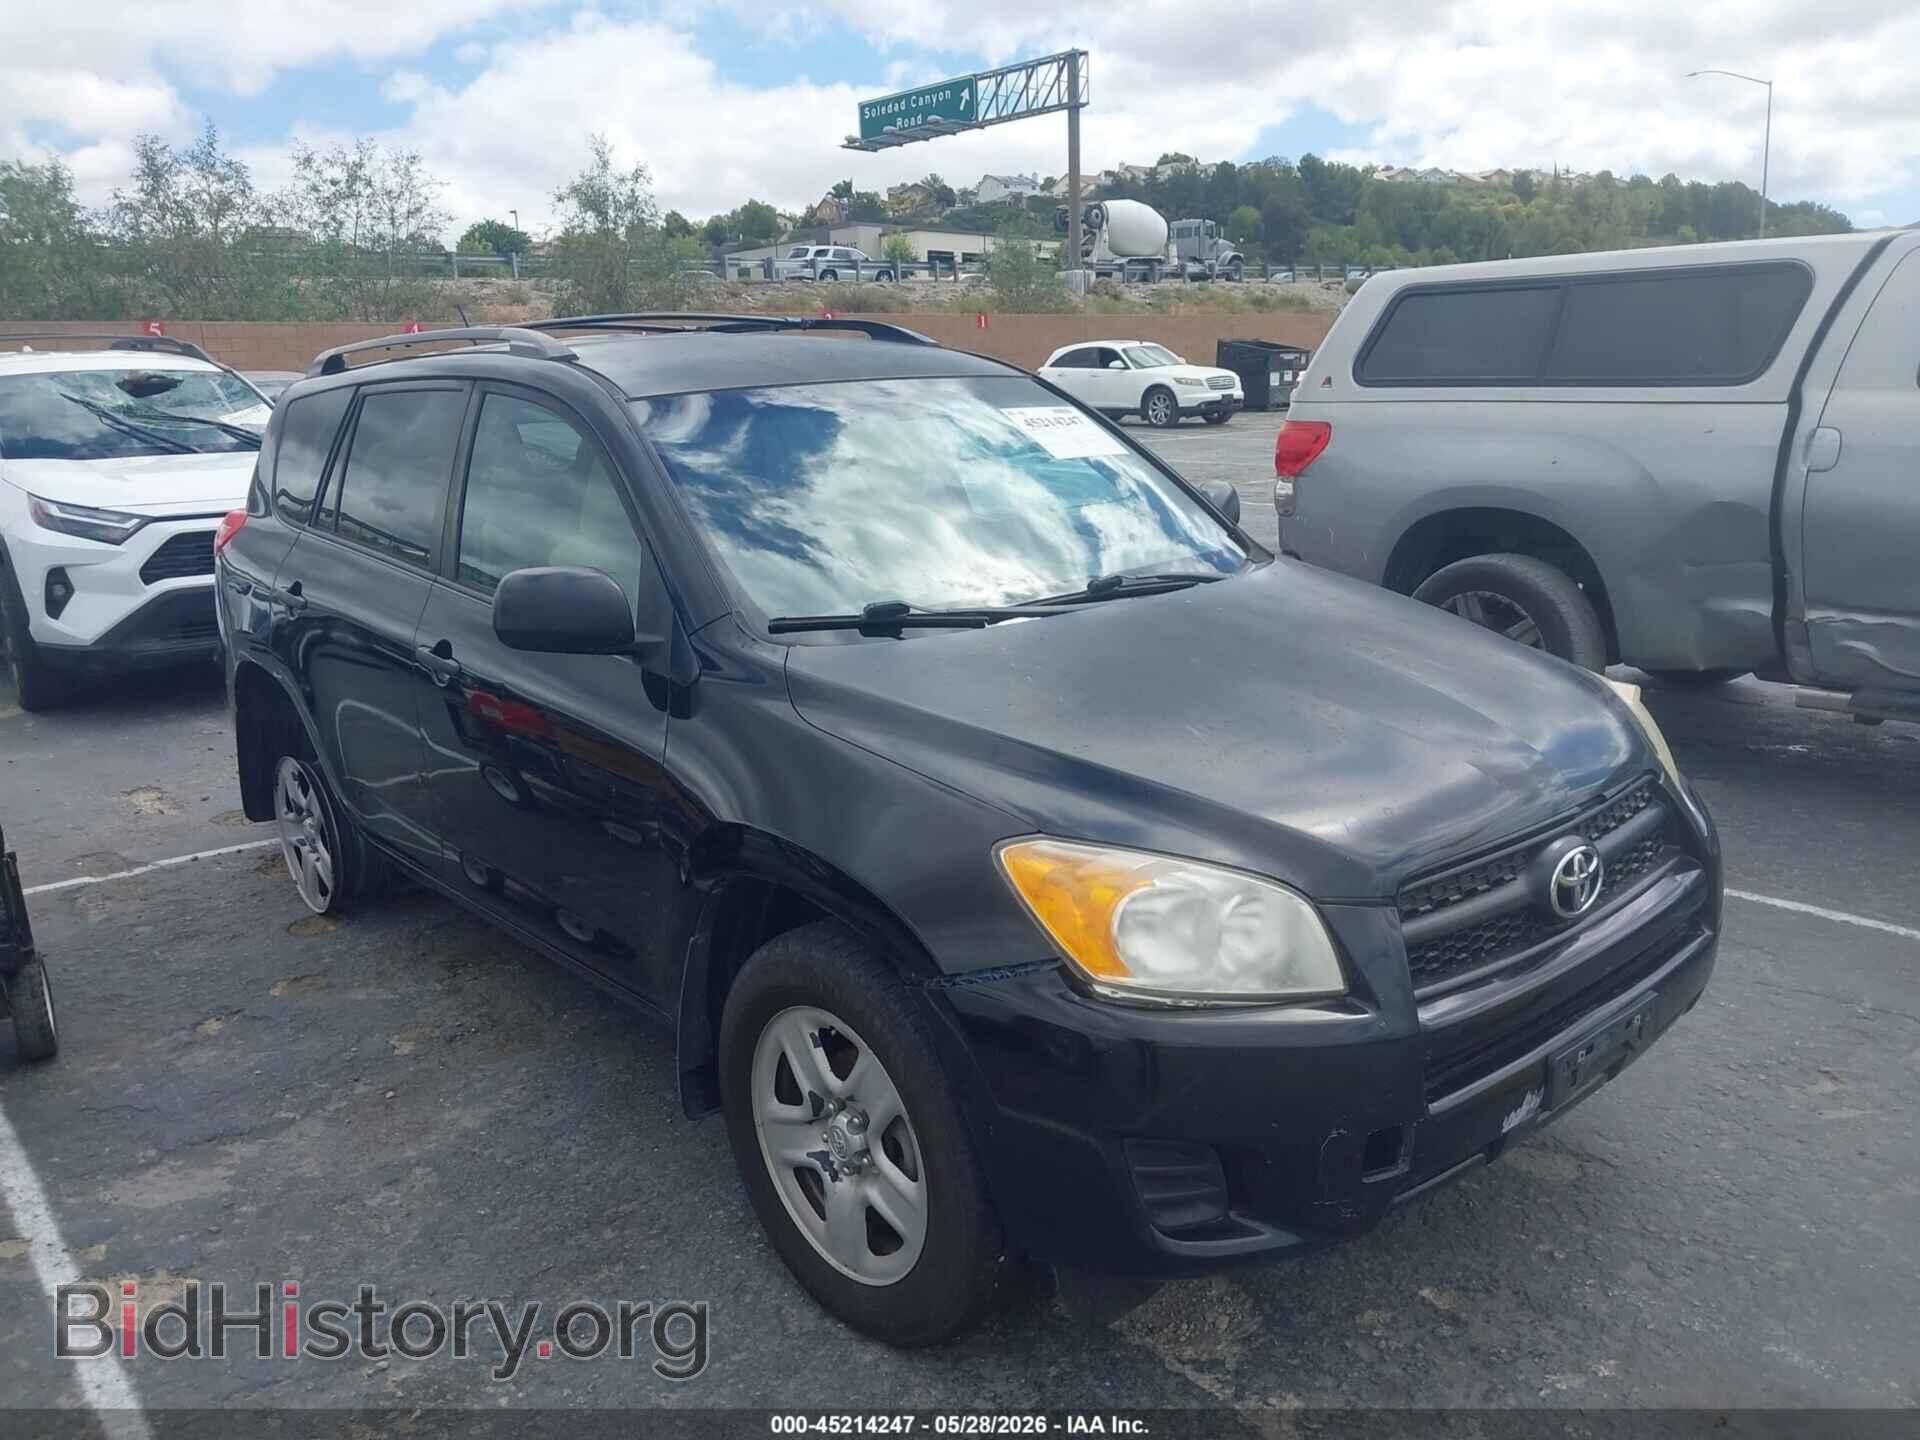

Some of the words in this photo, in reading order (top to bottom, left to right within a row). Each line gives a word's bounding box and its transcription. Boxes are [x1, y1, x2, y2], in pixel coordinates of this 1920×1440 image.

[863, 99, 906, 119] Soledad
[910, 89, 951, 107] Canyon
[896, 114, 922, 129] Road
[980, 315, 985, 328] 1
[149, 322, 161, 336] 5
